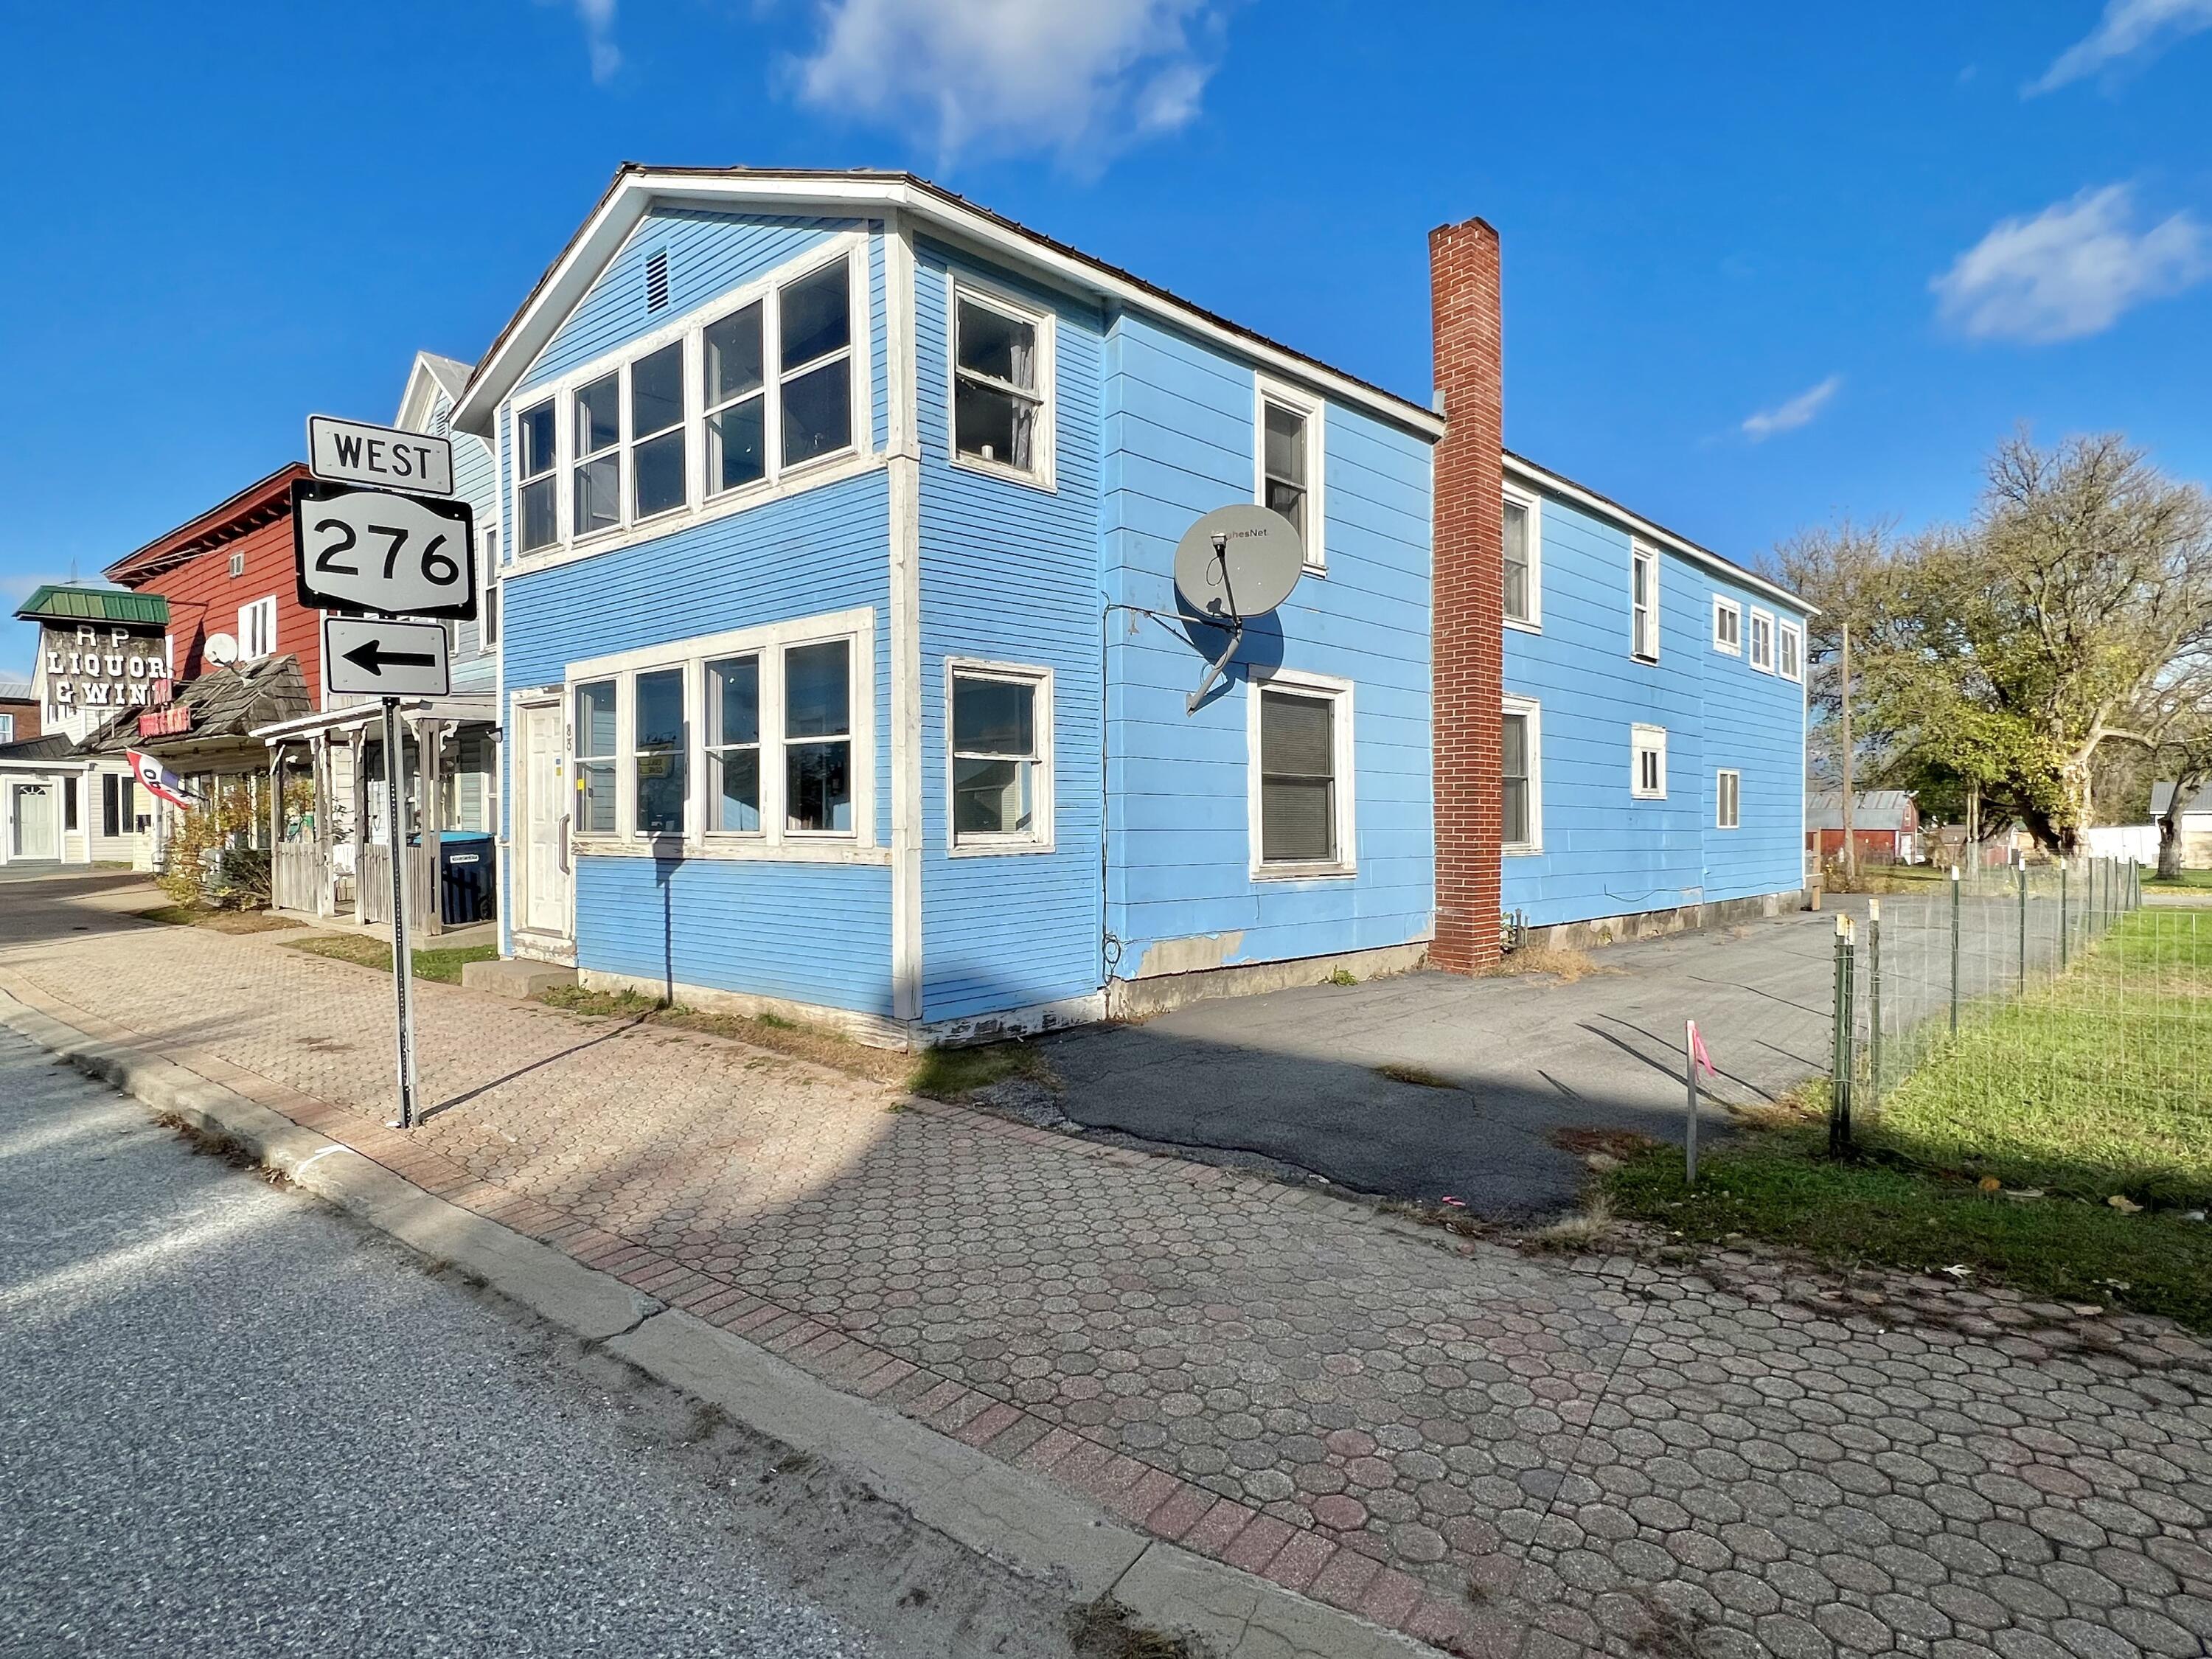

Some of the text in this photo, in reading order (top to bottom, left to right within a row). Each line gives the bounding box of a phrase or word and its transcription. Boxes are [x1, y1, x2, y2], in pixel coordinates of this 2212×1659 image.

[334, 433, 431, 479] WEST
[313, 518, 459, 586] 276
[77, 625, 129, 648] R P
[47, 651, 167, 678] LIQUOR
[56, 681, 74, 703] &
[82, 682, 156, 706] WIN
